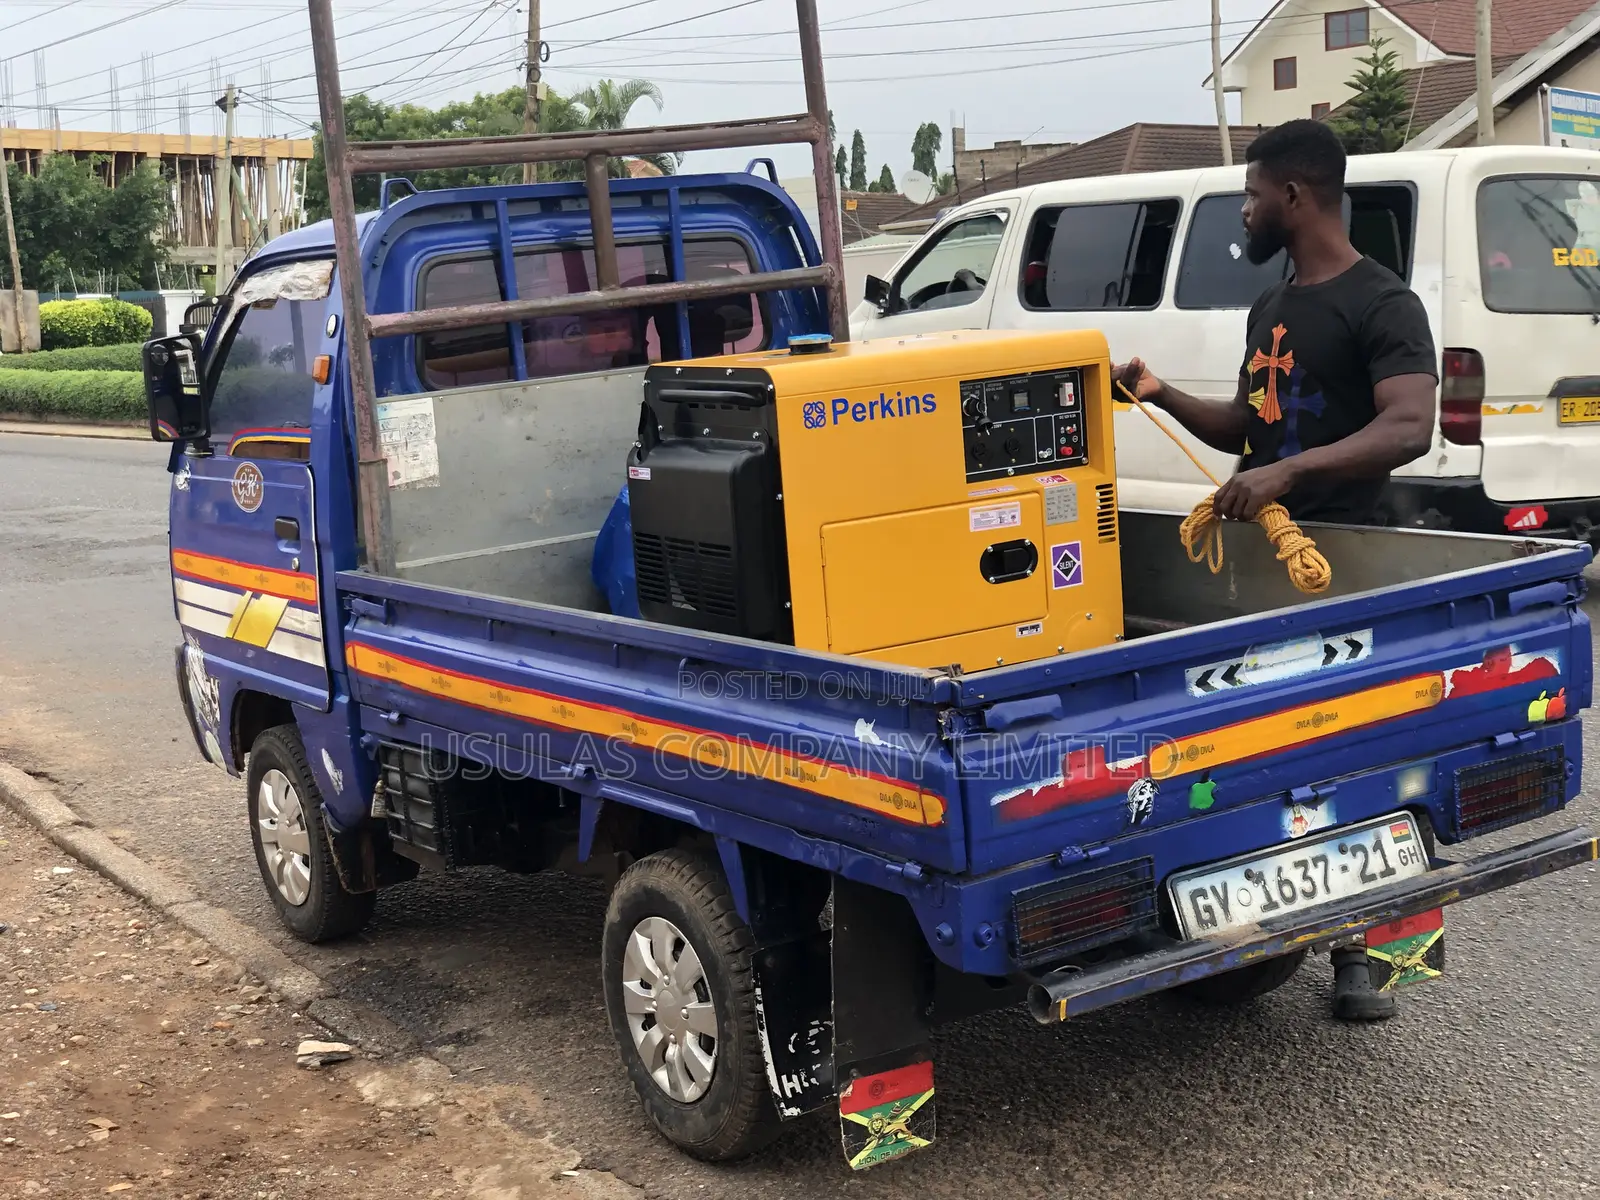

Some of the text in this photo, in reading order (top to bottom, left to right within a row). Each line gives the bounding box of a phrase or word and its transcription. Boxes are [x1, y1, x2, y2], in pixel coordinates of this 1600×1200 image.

[1552, 247, 1599, 266] GOD
[832, 392, 937, 425] Perkins
[1060, 560, 1074, 570] SILENT
[1188, 881, 1232, 930] GY
[1398, 845, 1420, 867] GH
